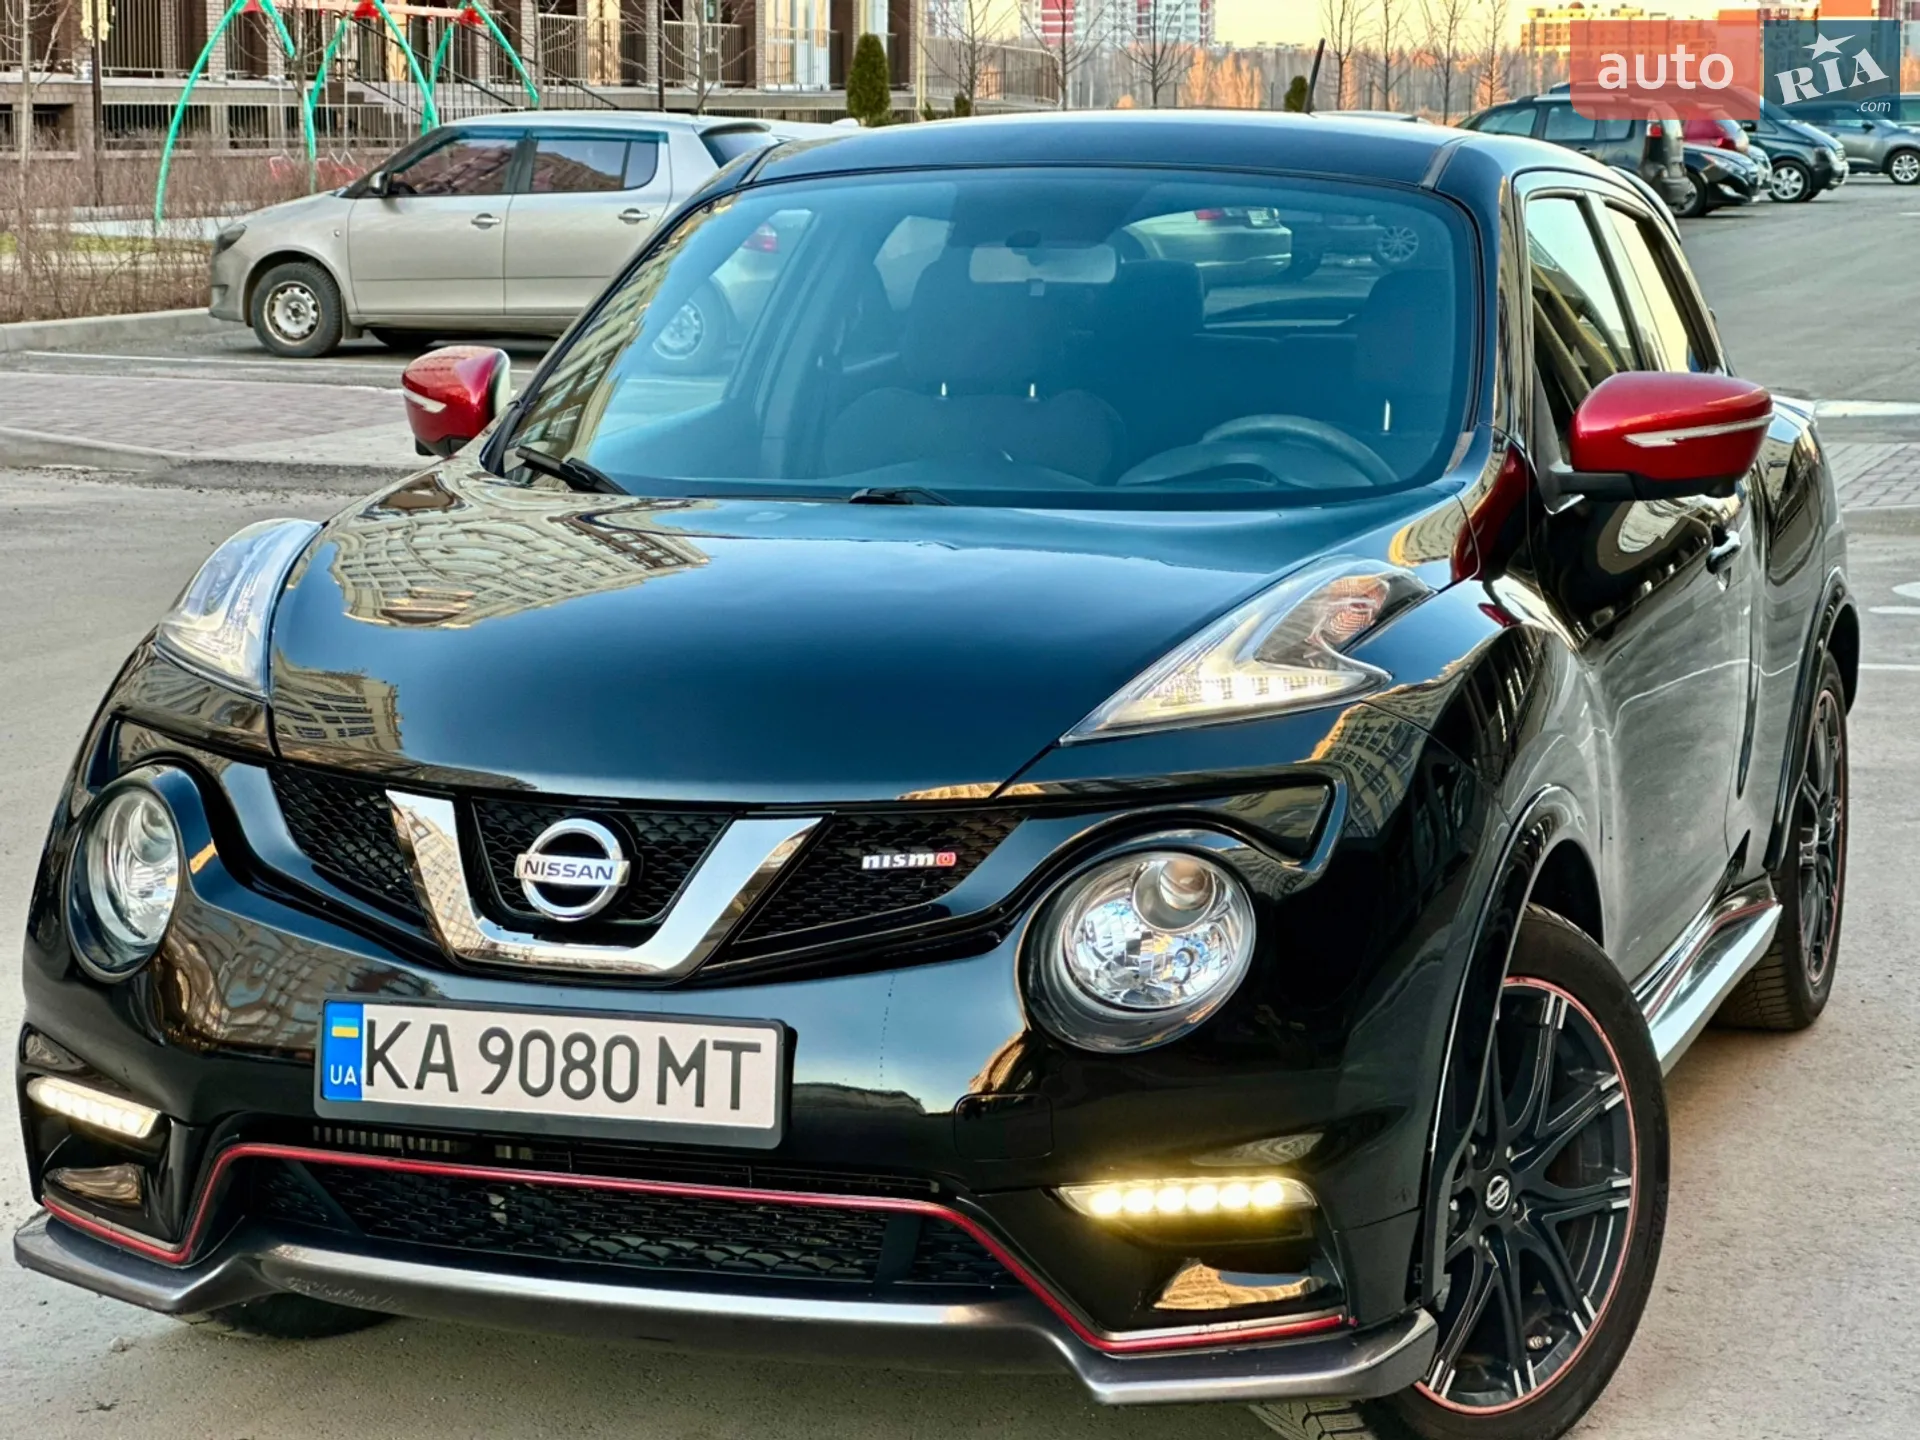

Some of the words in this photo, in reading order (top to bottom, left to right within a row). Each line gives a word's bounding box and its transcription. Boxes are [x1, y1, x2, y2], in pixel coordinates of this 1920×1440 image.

[523, 860, 614, 881] NISSAN
[862, 852, 957, 870] nismo
[330, 1064, 357, 1086] UA
[365, 1018, 459, 1093] KA
[478, 1026, 640, 1104] 9080
[657, 1035, 762, 1111] MT
